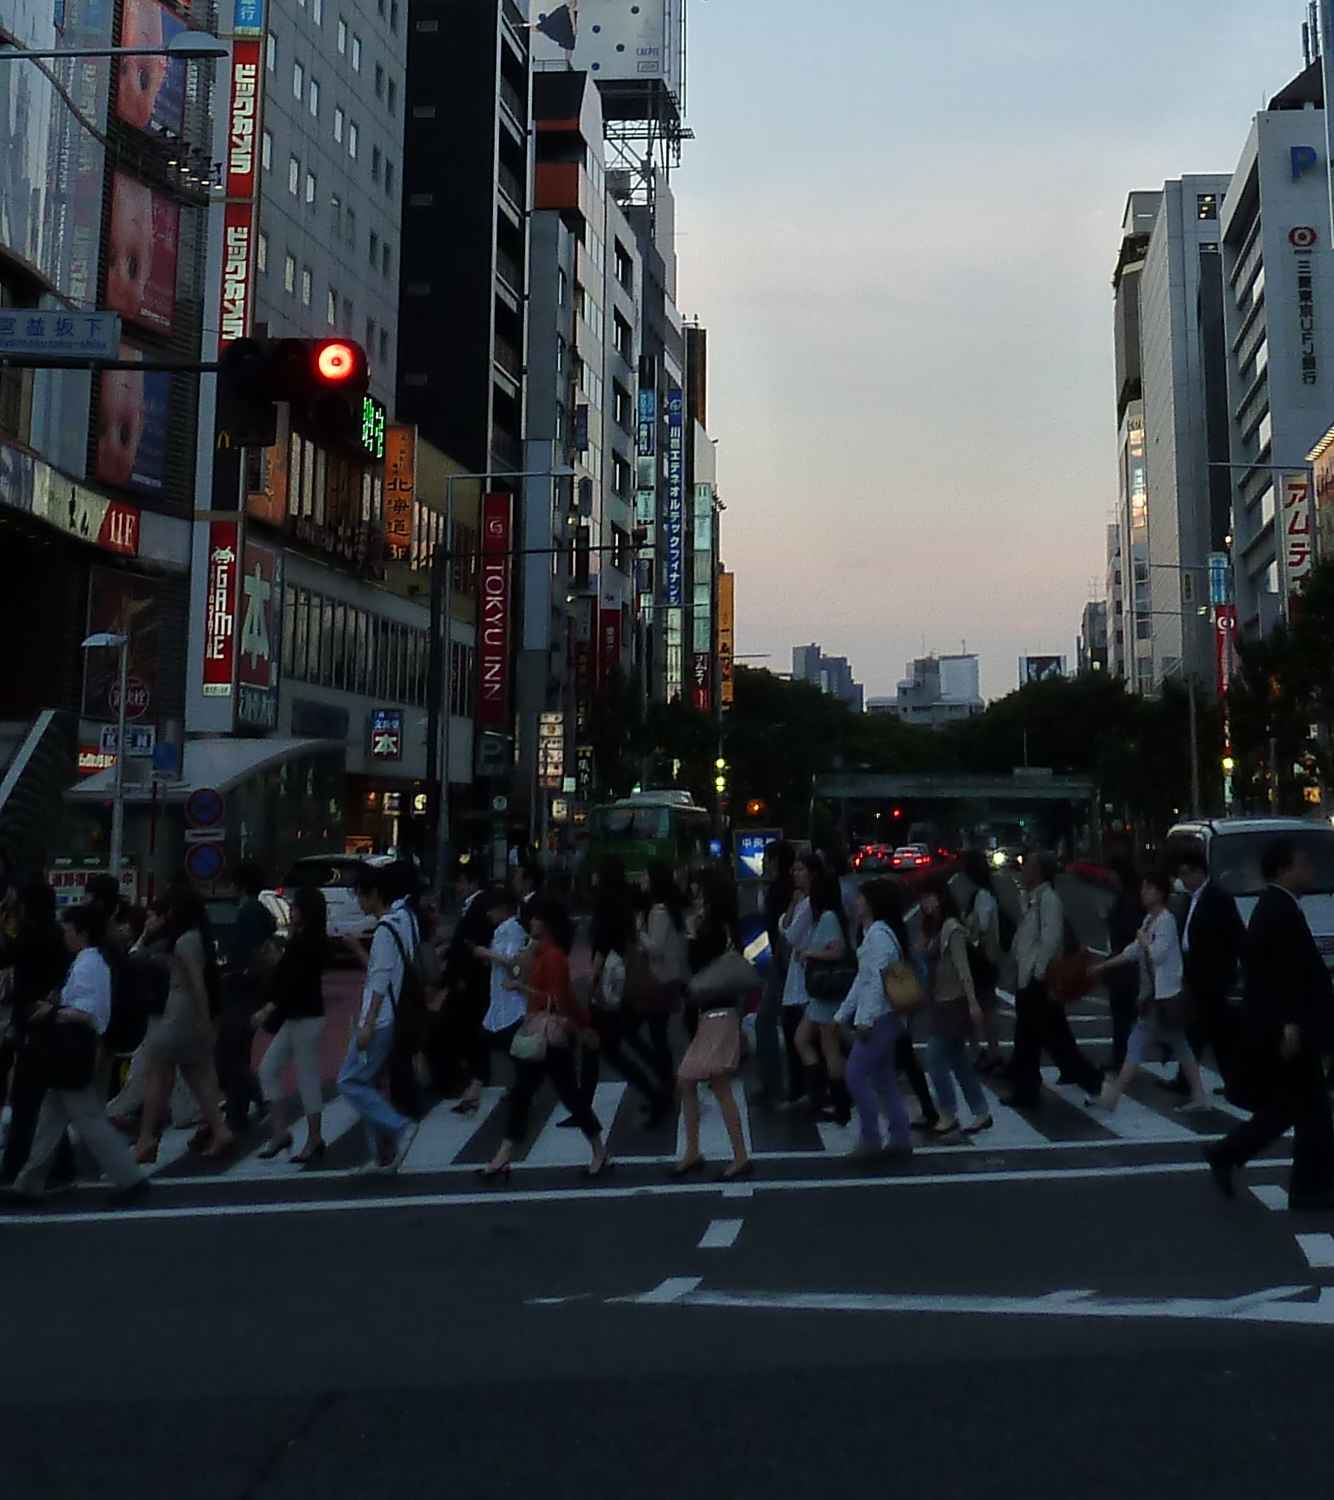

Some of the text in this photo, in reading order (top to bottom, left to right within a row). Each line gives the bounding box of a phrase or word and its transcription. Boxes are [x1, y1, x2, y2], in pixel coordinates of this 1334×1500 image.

[230, 63, 256, 174] ビックカメラ
[1290, 147, 1317, 179] P
[1298, 260, 1317, 386] 三菱東京UFJ銀行
[110, 509, 137, 548] 11F
[386, 478, 413, 537] 北海道
[390, 544, 406, 560] 3F
[213, 566, 233, 660] GAME
[483, 559, 505, 702] TOKYU INN
[373, 733, 398, 756] 本
